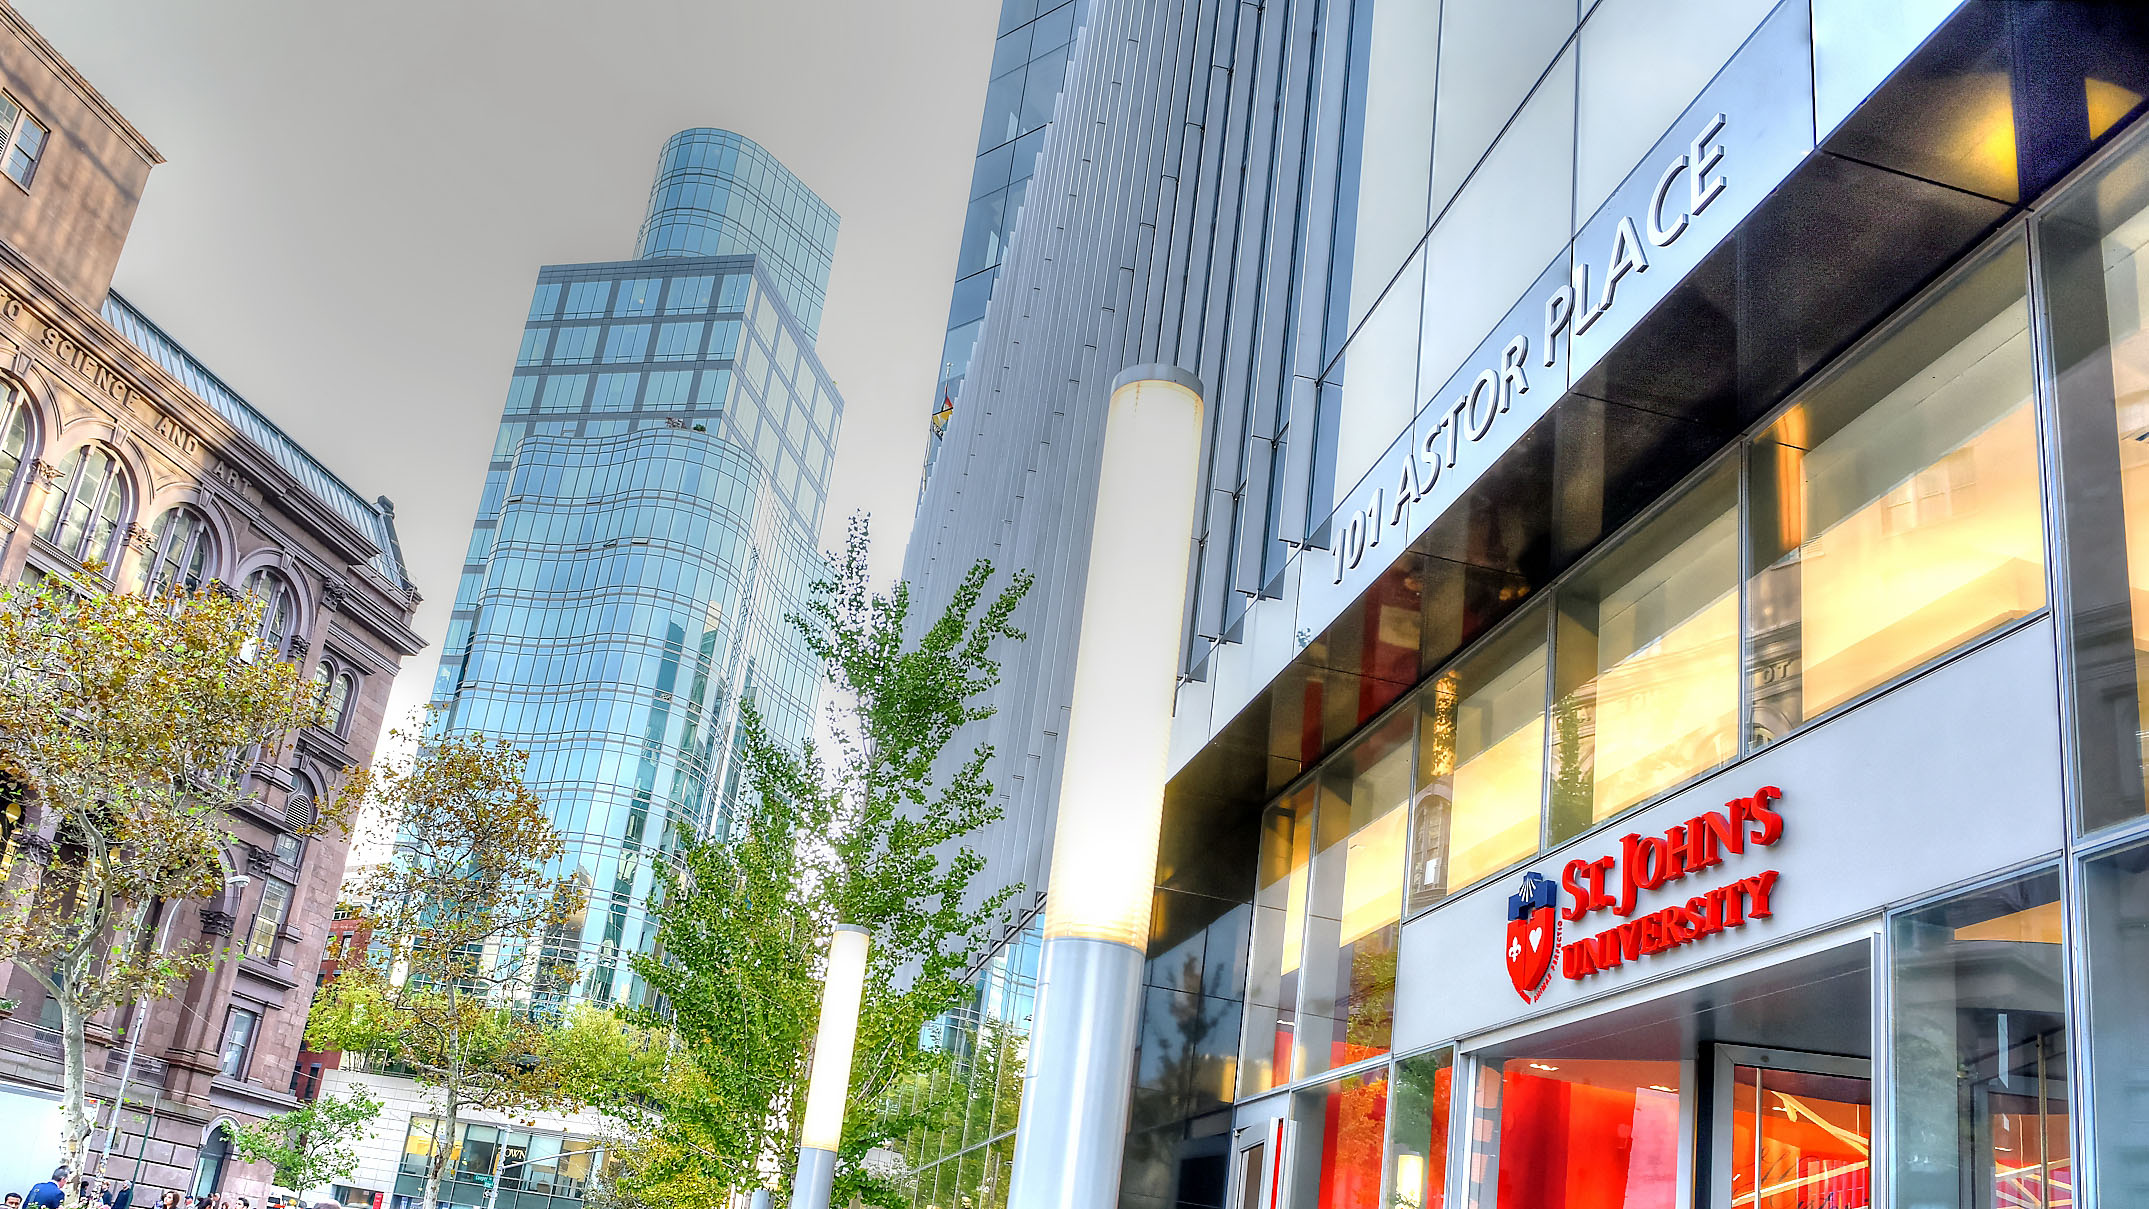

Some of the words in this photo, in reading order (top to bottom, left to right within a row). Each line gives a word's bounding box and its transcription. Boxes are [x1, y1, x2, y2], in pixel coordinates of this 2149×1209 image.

[41, 326, 141, 413] SCIENCE
[155, 416, 201, 456] AND
[1332, 488, 1383, 585] 101
[1390, 334, 1529, 526] ASTOR
[1544, 112, 1727, 367] PLACE
[1613, 785, 1783, 917] JOHN'S
[1561, 870, 1780, 980] UNIVERSITY
